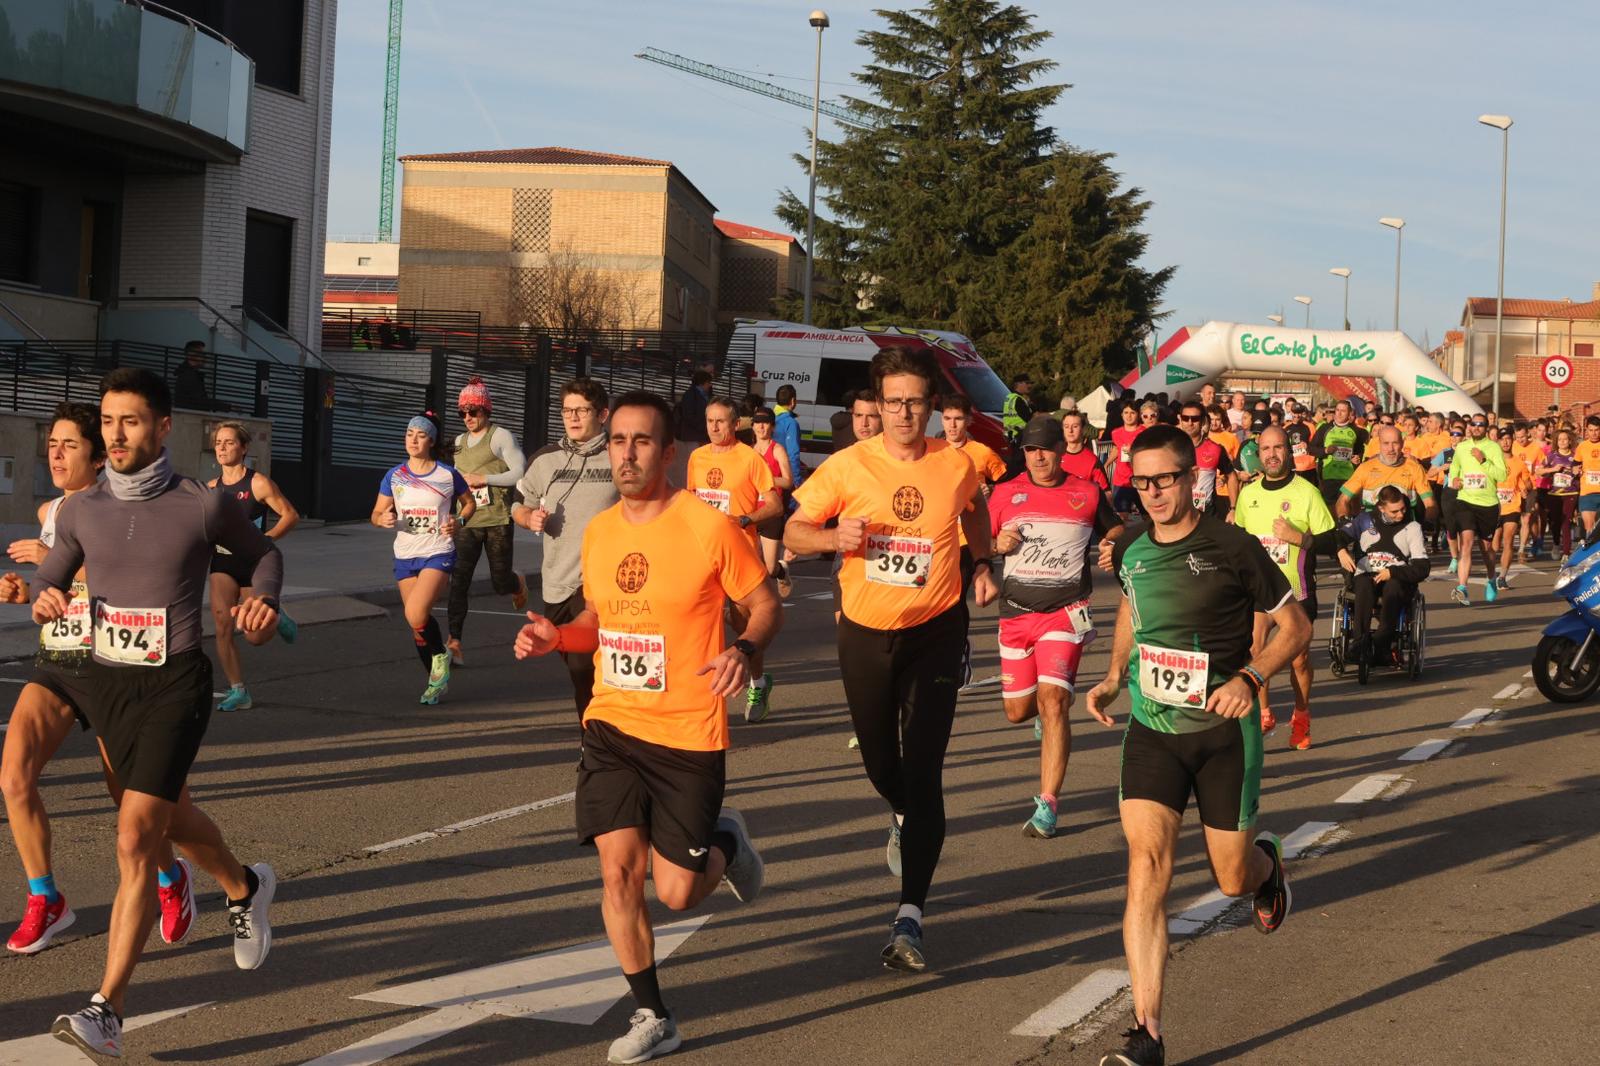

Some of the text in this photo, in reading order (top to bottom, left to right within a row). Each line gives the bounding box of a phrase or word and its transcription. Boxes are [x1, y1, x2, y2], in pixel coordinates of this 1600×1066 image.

[804, 332, 864, 343] AMBULANCIA
[1240, 333, 1376, 366] El Corte Inglés
[761, 370, 811, 383] Cruz Roja
[1549, 366, 1567, 377] 30
[408, 516, 430, 528] 222
[867, 537, 931, 555] bedunia
[878, 553, 917, 574] 396
[608, 600, 652, 616] UPSA
[51, 618, 83, 637] 258
[106, 627, 149, 650] 194
[600, 633, 662, 653] bedunia
[611, 652, 648, 676] 136
[1140, 646, 1206, 671] bedunia
[1151, 667, 1190, 693] 193
